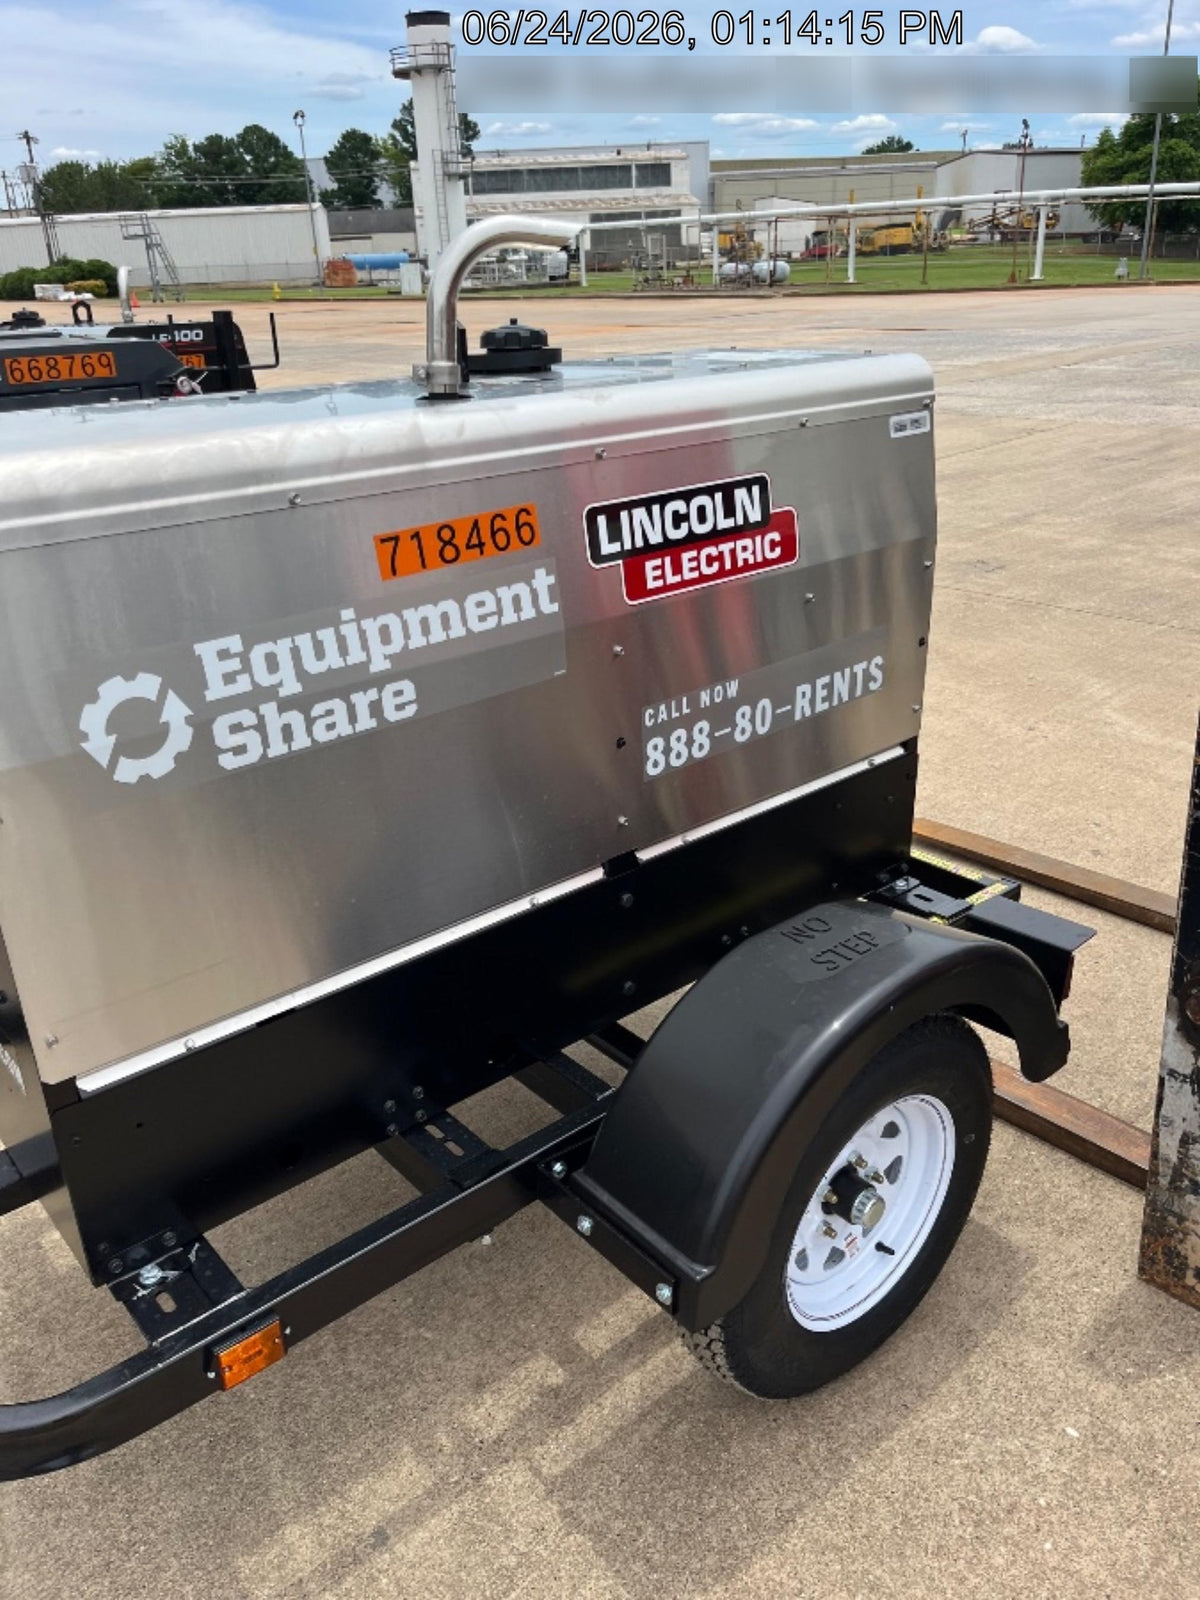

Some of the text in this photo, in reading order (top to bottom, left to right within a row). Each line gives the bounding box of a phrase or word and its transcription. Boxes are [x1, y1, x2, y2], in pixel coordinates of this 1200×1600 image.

[9, 353, 114, 383] 668769
[380, 507, 536, 577] 718466
[596, 484, 762, 556] LINCOLN
[644, 531, 782, 591] ELECTRIC
[193, 567, 560, 702] Equipment
[212, 678, 418, 771] Share
[644, 679, 739, 727] CALL NOW
[646, 655, 885, 777] 888-80-RENTS
[780, 917, 832, 945] NO
[810, 931, 879, 972] STEP
